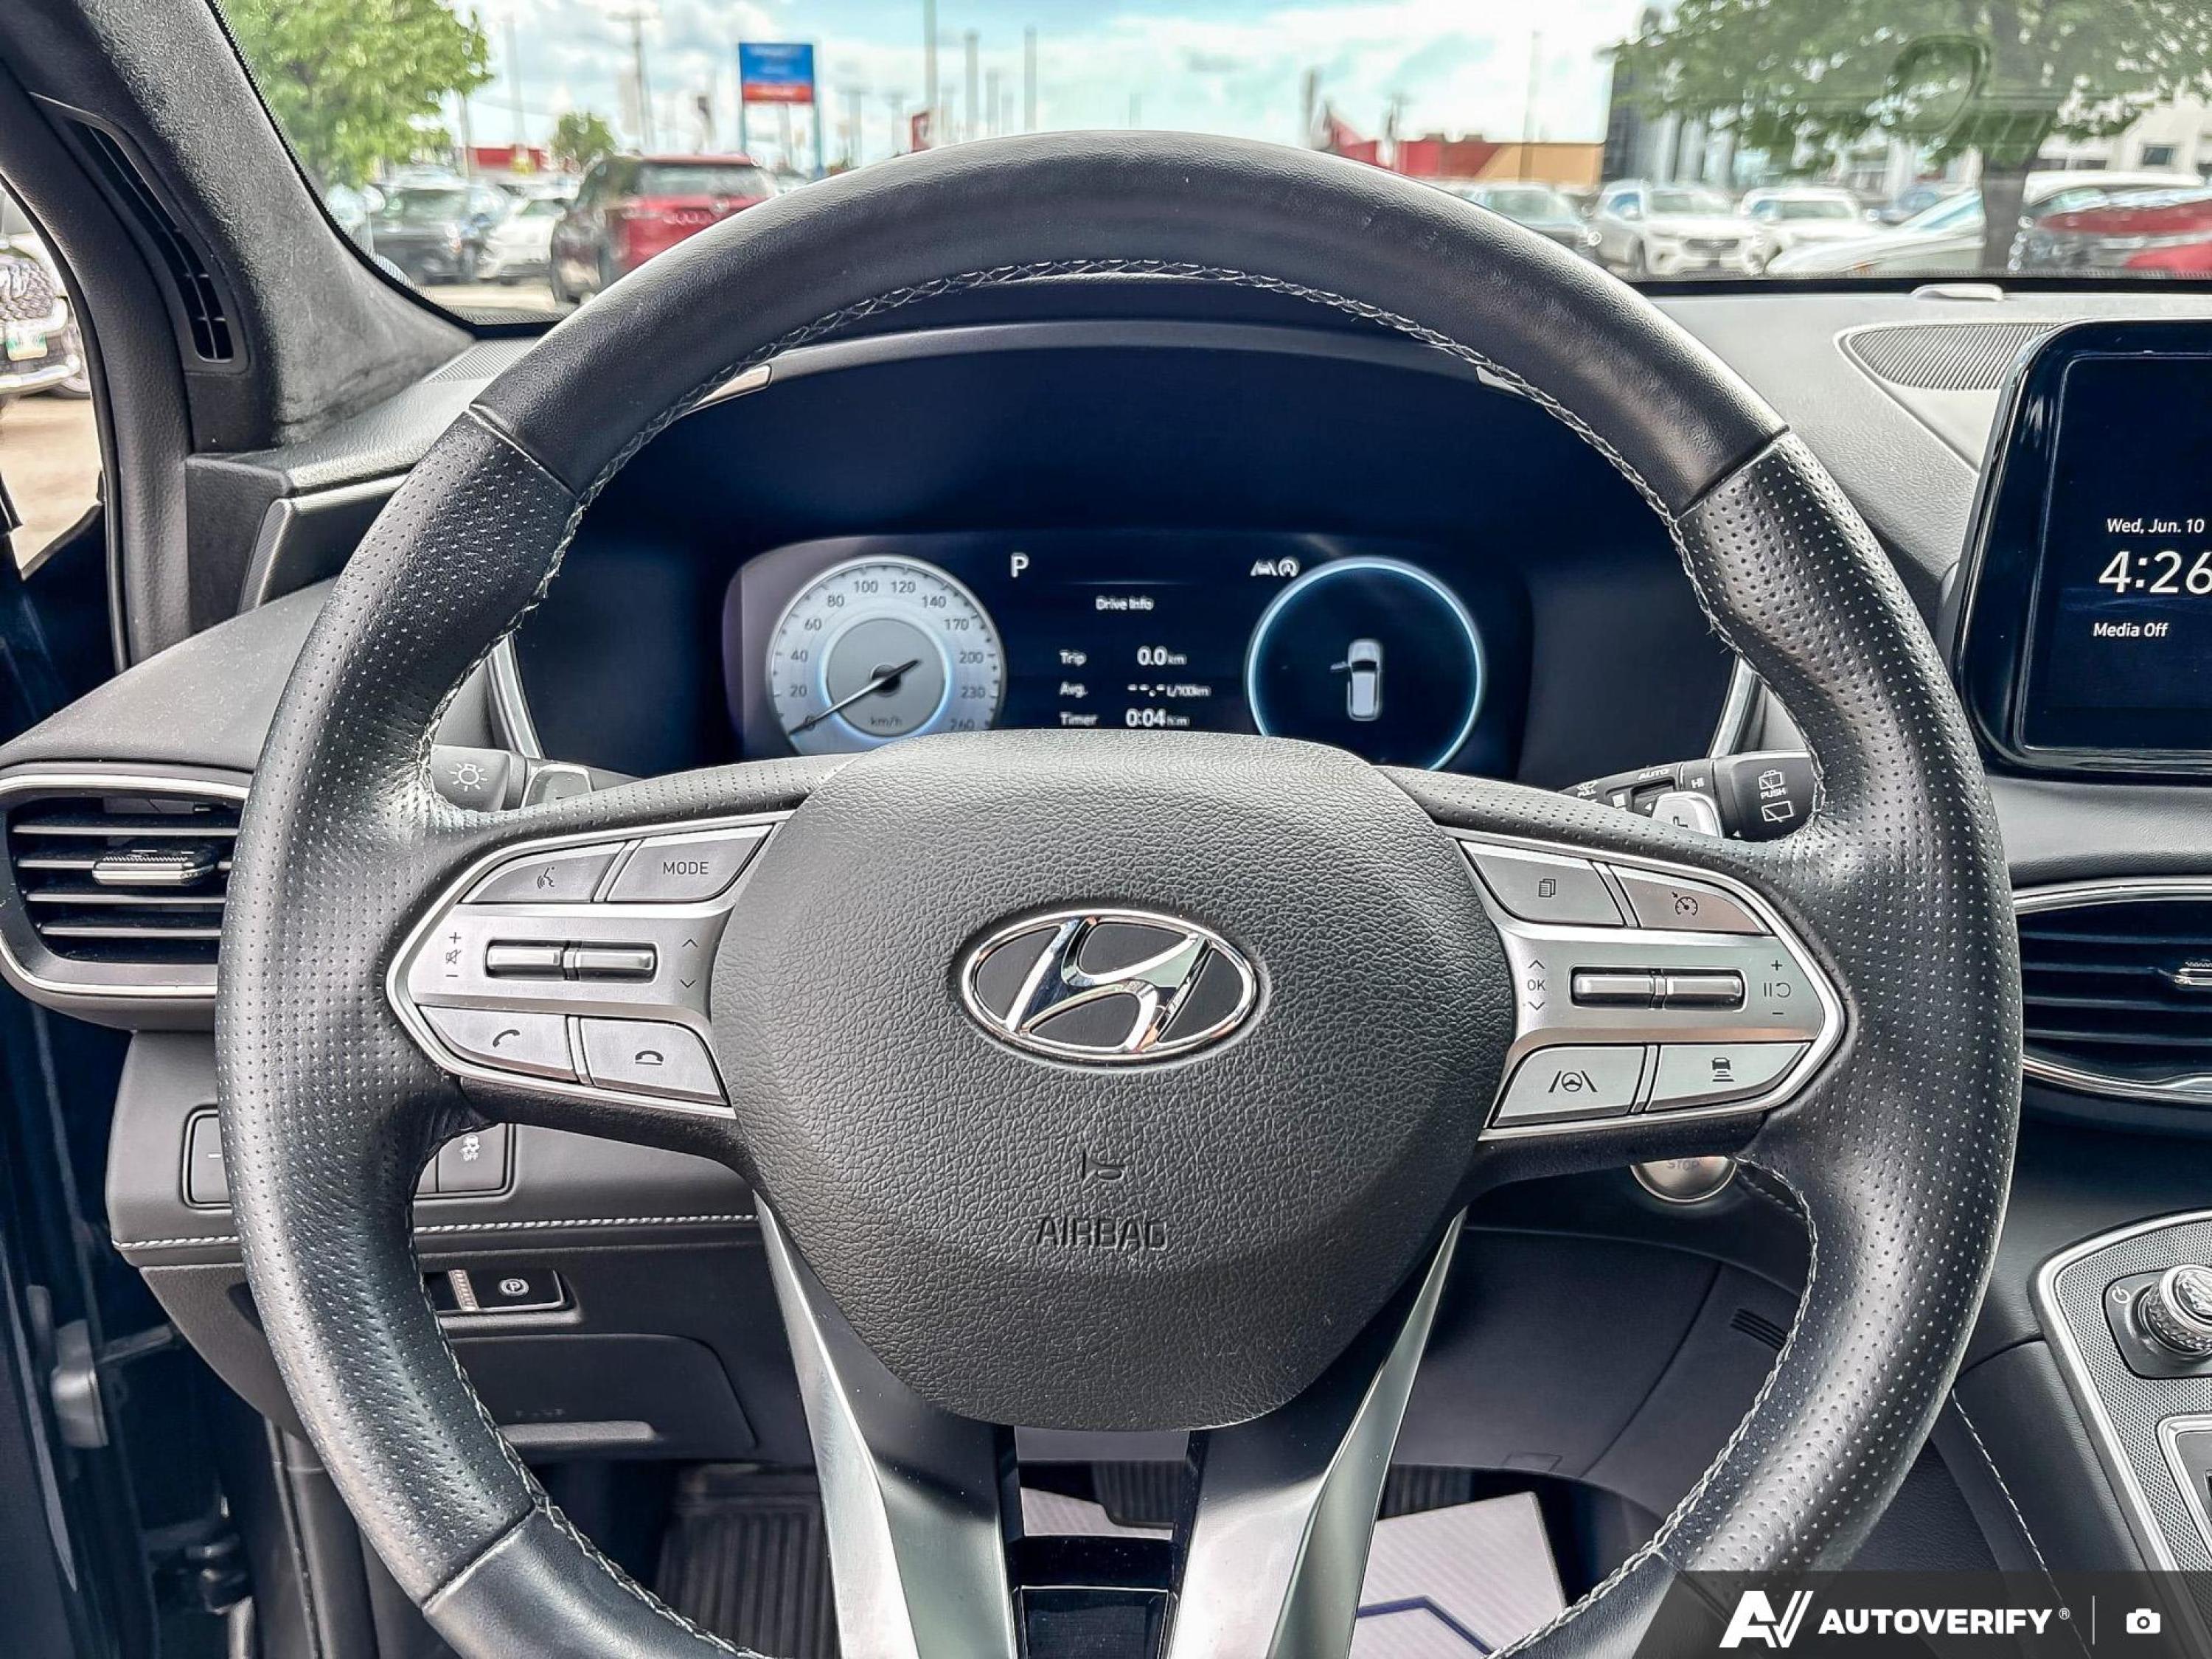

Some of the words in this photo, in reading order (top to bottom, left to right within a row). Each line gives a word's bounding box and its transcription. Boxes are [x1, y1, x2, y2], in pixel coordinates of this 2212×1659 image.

[2107, 518, 2144, 534] Wed,
[2148, 518, 2182, 533] Jun.
[2186, 518, 2205, 533] 10
[1010, 553, 1029, 578] P
[2098, 550, 2212, 594] 4:26
[854, 580, 879, 593] 100
[891, 580, 916, 594] 120
[827, 595, 844, 608] 80
[922, 595, 947, 608] 140
[1096, 596, 1127, 611] Drive
[1129, 596, 1155, 611] Info
[804, 618, 822, 630] 60
[945, 618, 970, 631] 170
[2093, 623, 2140, 636] Media
[2143, 622, 2168, 636] Off
[790, 650, 808, 662] 40
[959, 651, 984, 664] 200
[1060, 650, 1087, 667] Trip
[1137, 645, 1167, 666] 0.0
[1167, 654, 1187, 665] km
[790, 685, 807, 698] 20
[961, 686, 986, 699] 230
[1060, 681, 1088, 698] Avg.
[871, 717, 902, 726] km/h
[1060, 712, 1098, 726] Timer
[1125, 709, 1166, 727] 0:04
[1638, 768, 1670, 780] AUTO
[1691, 777, 1705, 788] HI
[663, 861, 709, 875] MODE
[1527, 979, 1545, 991] OK
[1036, 1217, 1168, 1251] AIRBAG
